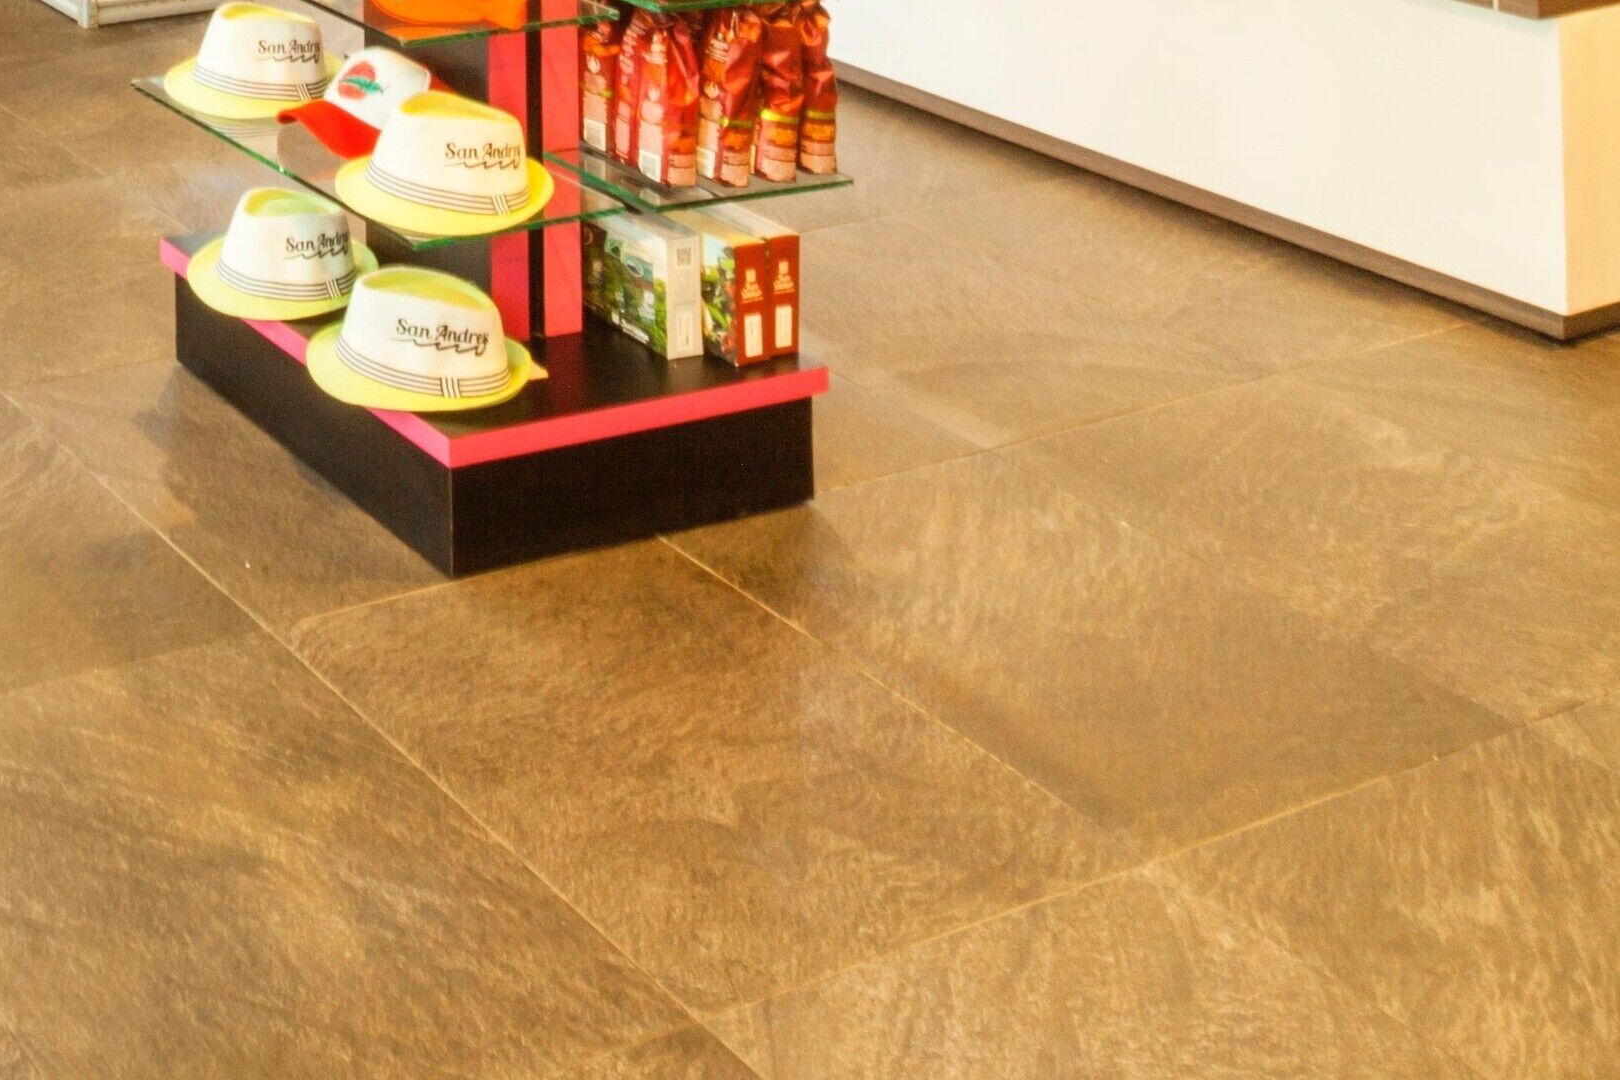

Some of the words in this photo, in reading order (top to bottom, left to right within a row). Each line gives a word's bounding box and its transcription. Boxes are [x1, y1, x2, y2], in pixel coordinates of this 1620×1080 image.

[258, 39, 285, 55] San
[445, 142, 479, 160] San
[286, 237, 316, 253] San
[396, 318, 430, 339] San
